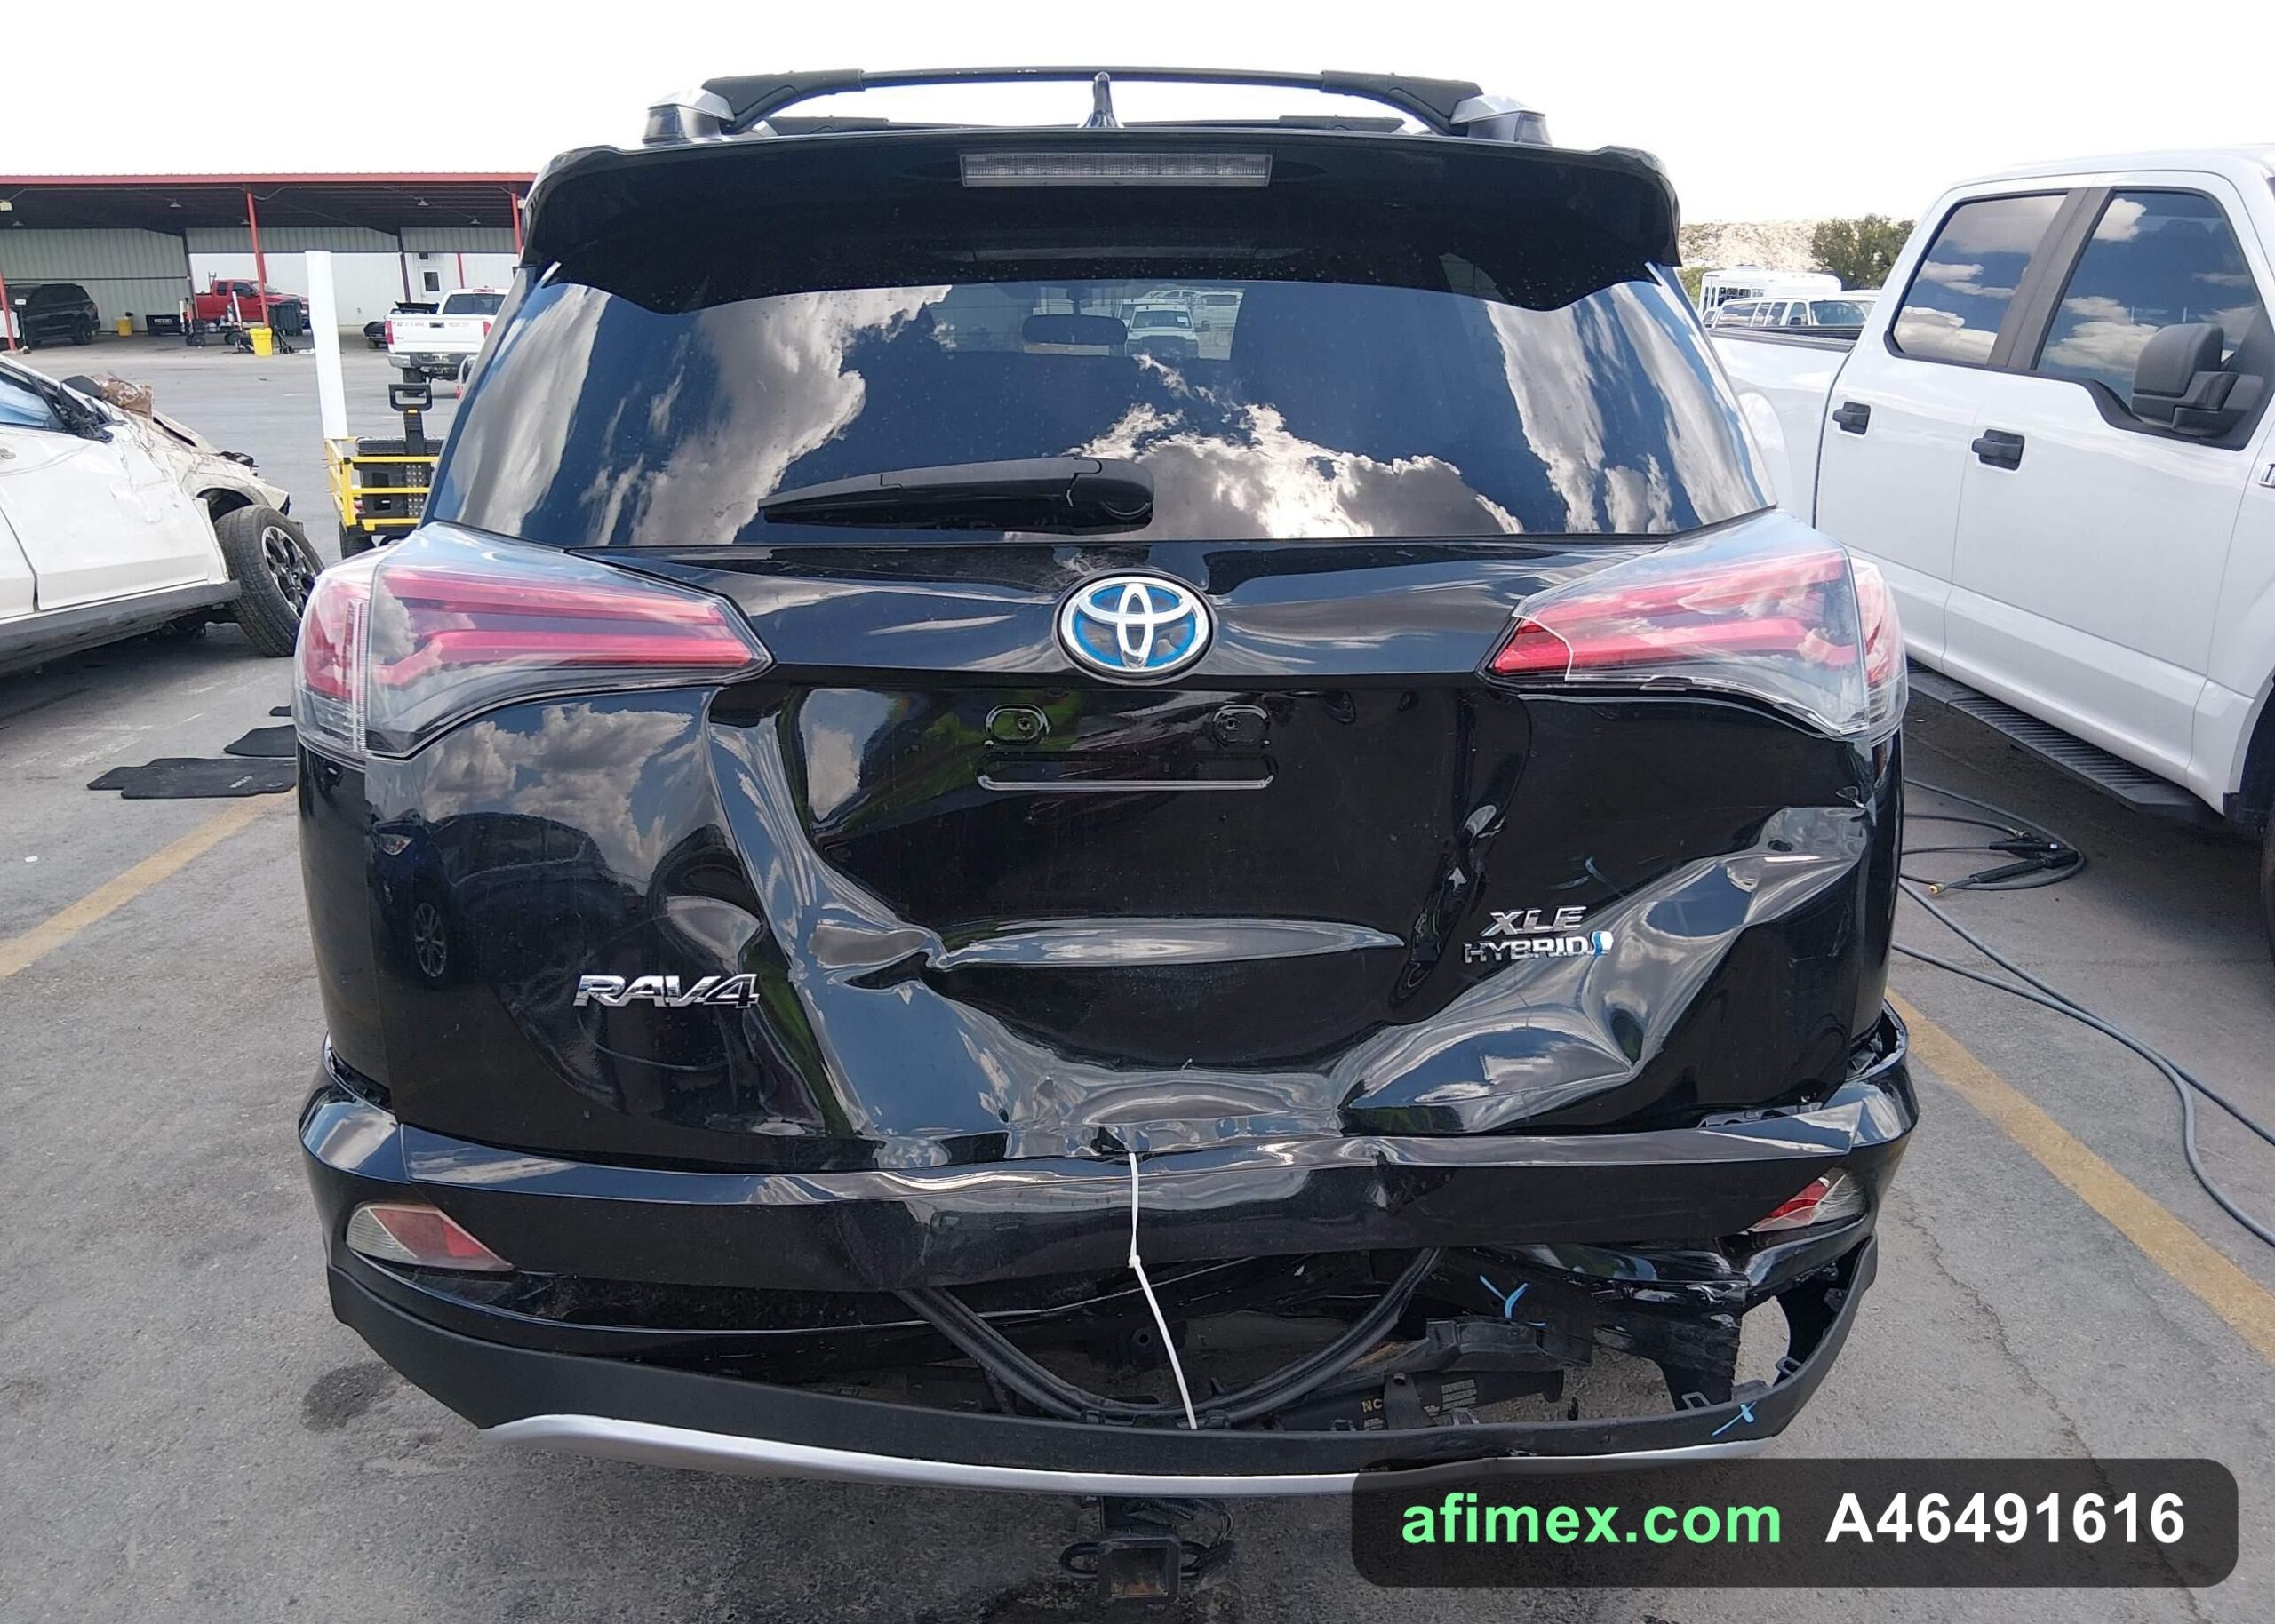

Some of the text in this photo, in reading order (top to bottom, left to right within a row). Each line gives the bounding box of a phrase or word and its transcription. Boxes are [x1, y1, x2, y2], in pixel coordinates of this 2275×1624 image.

[1481, 906, 1586, 936] XLE
[1465, 935, 1588, 963] HYBRID
[573, 974, 760, 1008] RAV4
